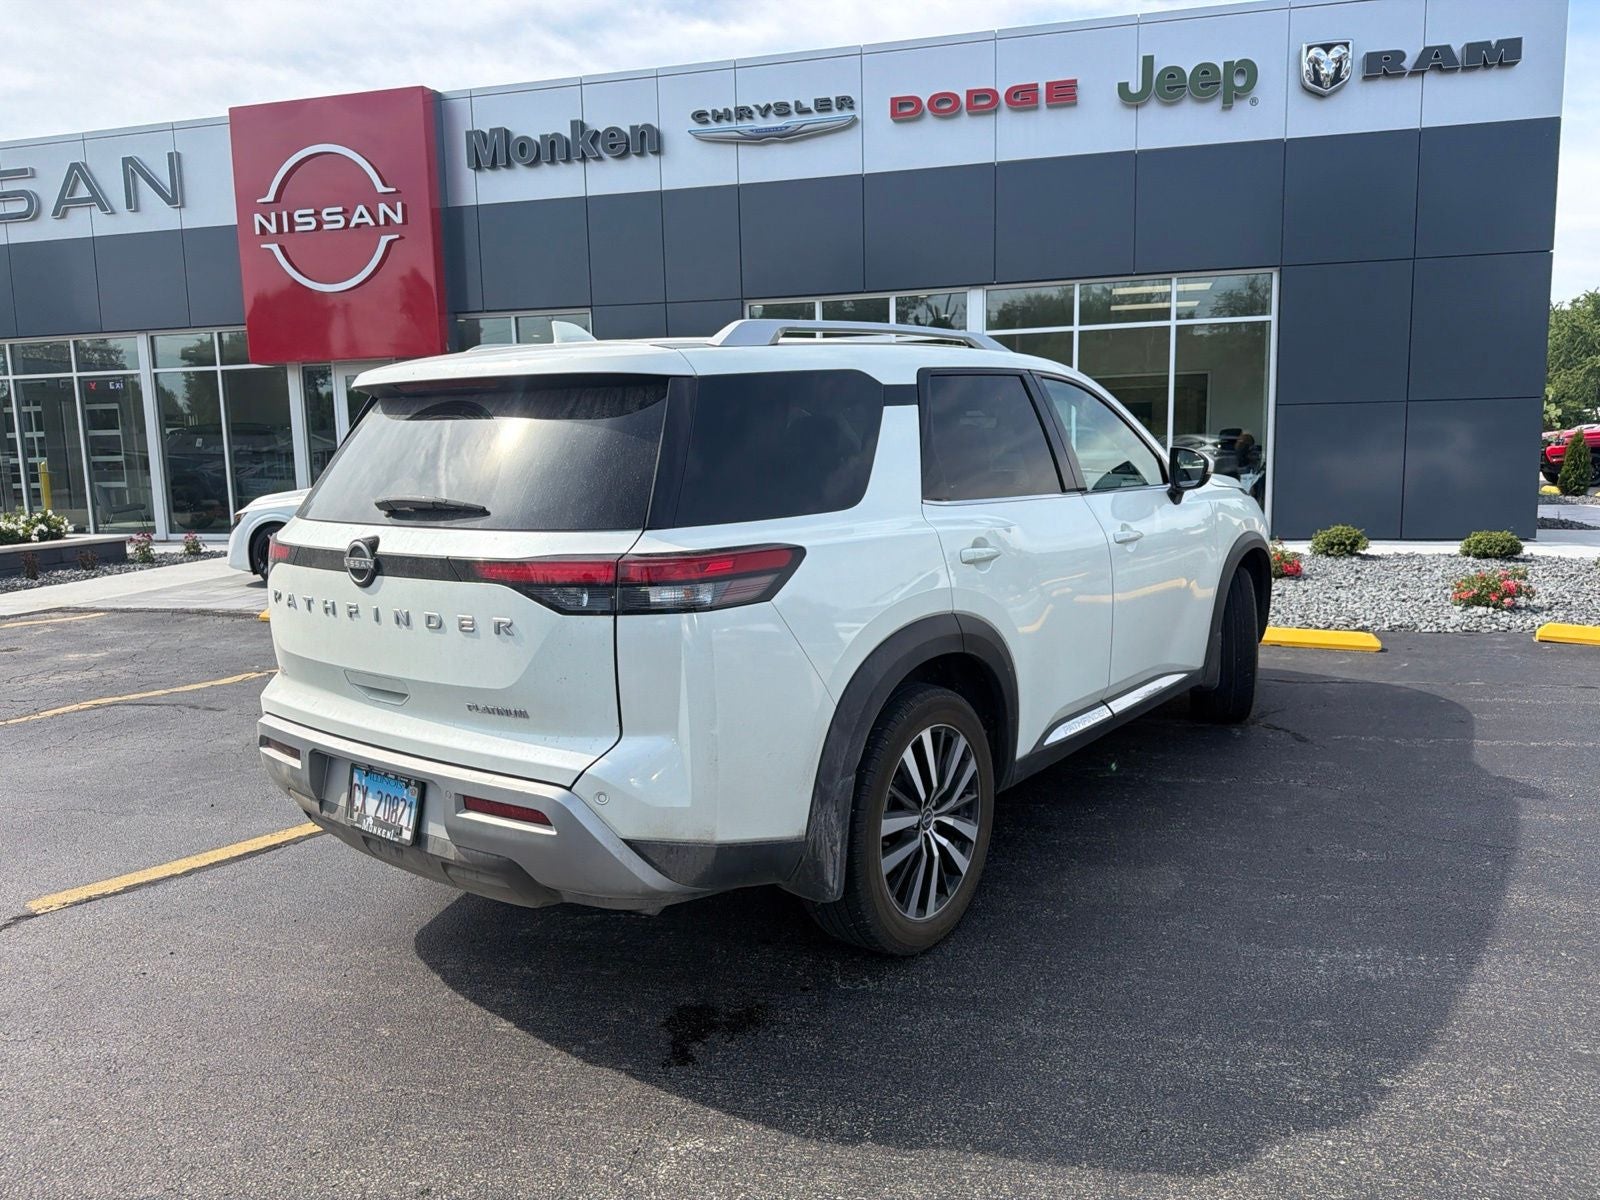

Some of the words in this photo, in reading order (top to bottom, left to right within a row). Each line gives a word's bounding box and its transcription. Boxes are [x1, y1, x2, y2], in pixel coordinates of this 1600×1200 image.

[1361, 36, 1523, 79] RAM
[890, 78, 1079, 122] DODGE
[1117, 54, 1260, 111] Jeep
[691, 95, 855, 124] CHRYSLER
[465, 119, 662, 170] Monken
[253, 201, 404, 235] NISSAN
[273, 589, 515, 636] PATHFINDER
[465, 702, 530, 719] PLATINUM
[350, 782, 369, 815] CX
[374, 790, 412, 832] 20821
